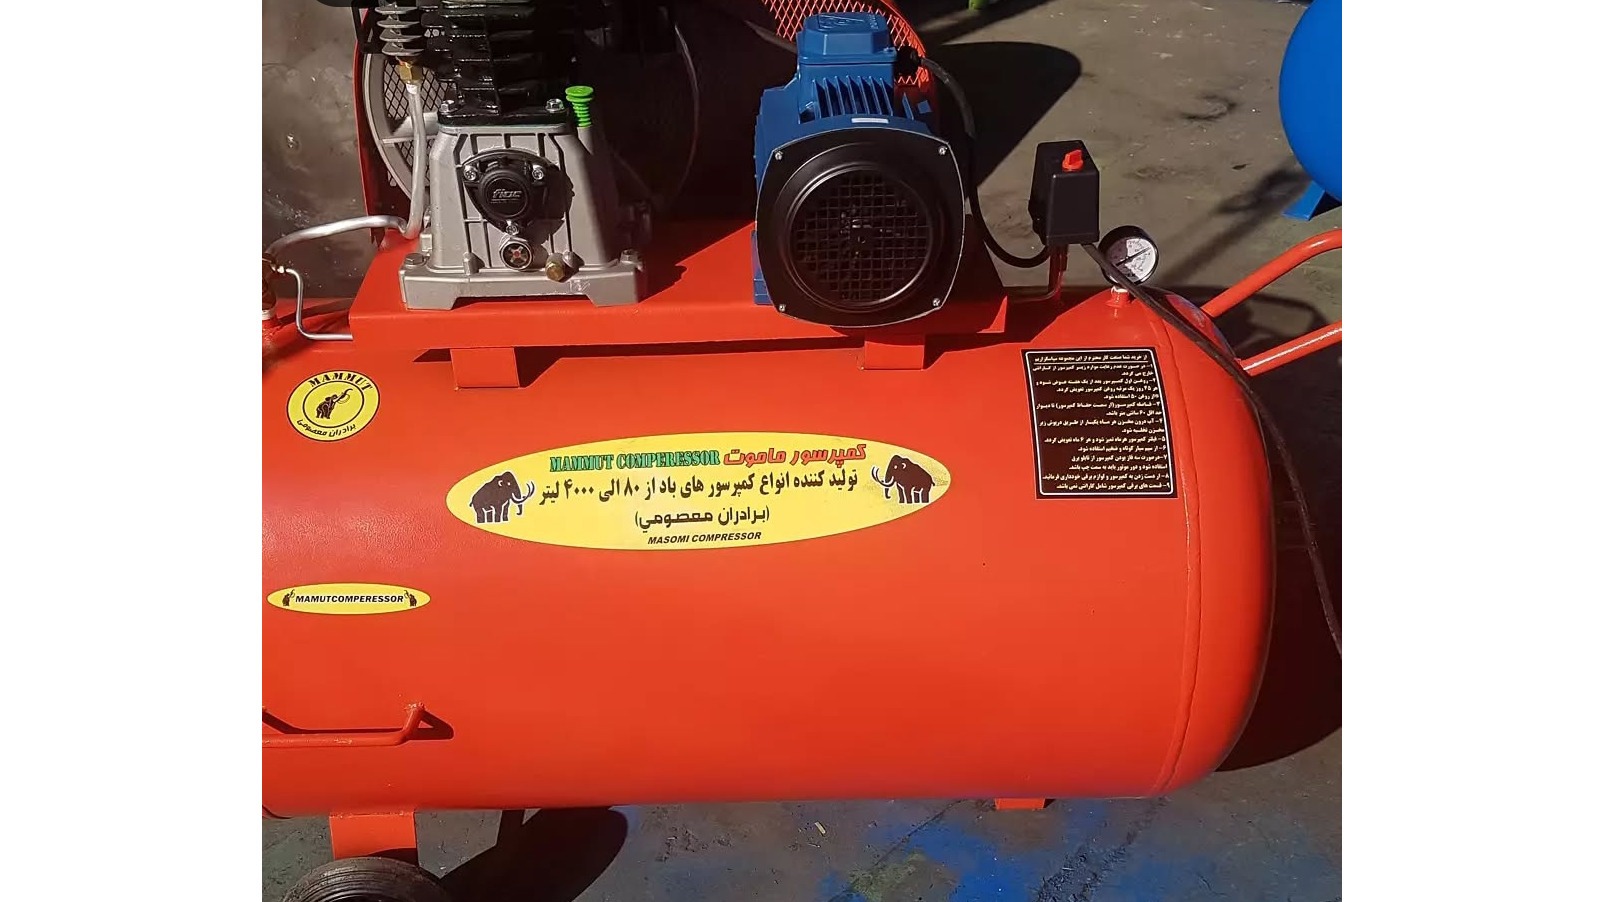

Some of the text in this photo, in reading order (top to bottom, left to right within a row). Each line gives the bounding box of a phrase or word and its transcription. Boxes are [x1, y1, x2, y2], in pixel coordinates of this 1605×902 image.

[308, 372, 373, 391] MAMMUT
[549, 449, 720, 472] MAMMUT COMPERESSOR
[723, 443, 867, 468] کمپرسور ماموت
[539, 468, 858, 506] تولید کننده انواع کمپرسور های باد از ۸۰ الی ۴۰۰۰ لیتر
[647, 531, 762, 545] MASOMI COMPRESSOR
[295, 595, 404, 603] MAMUTCOMPERESSOR
